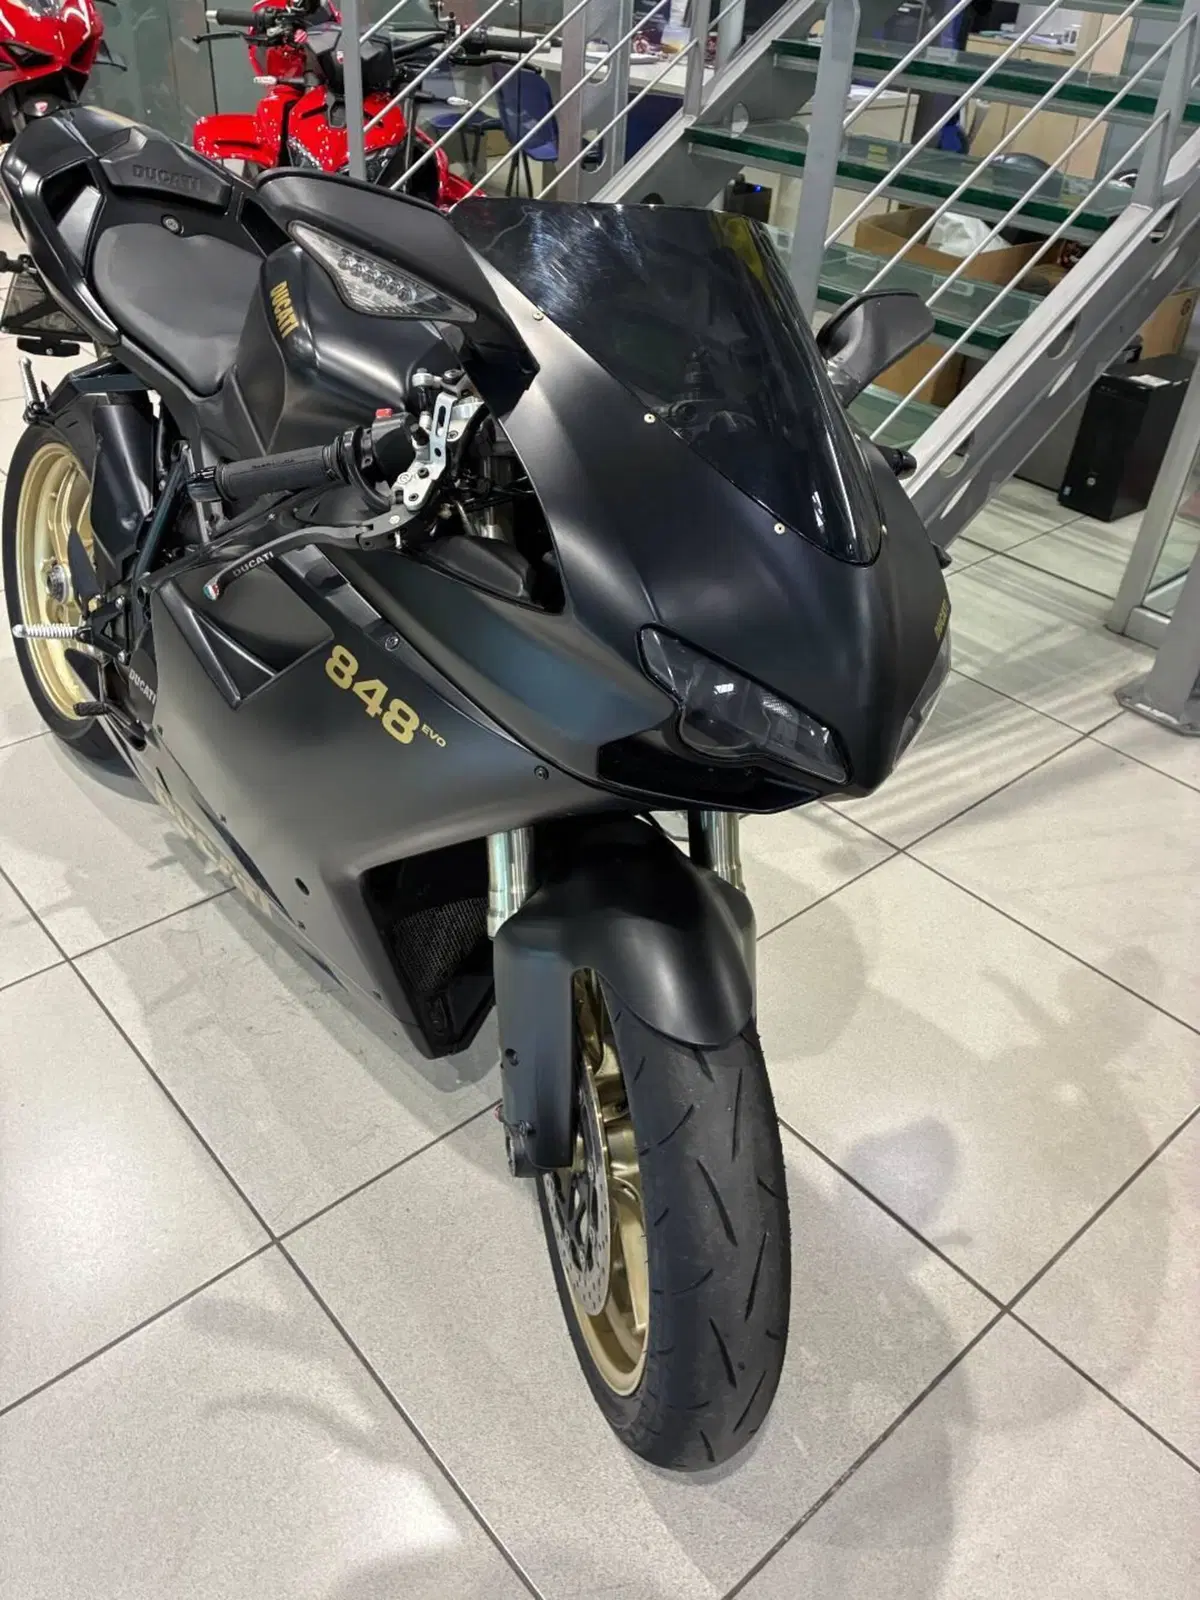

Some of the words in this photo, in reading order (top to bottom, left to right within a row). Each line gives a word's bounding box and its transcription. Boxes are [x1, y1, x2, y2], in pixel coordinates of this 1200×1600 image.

[270, 280, 299, 339] DUCATI
[232, 551, 274, 577] DUCATI
[129, 668, 156, 705] DUCATI
[325, 644, 420, 745] 848
[421, 723, 447, 748] EVO
